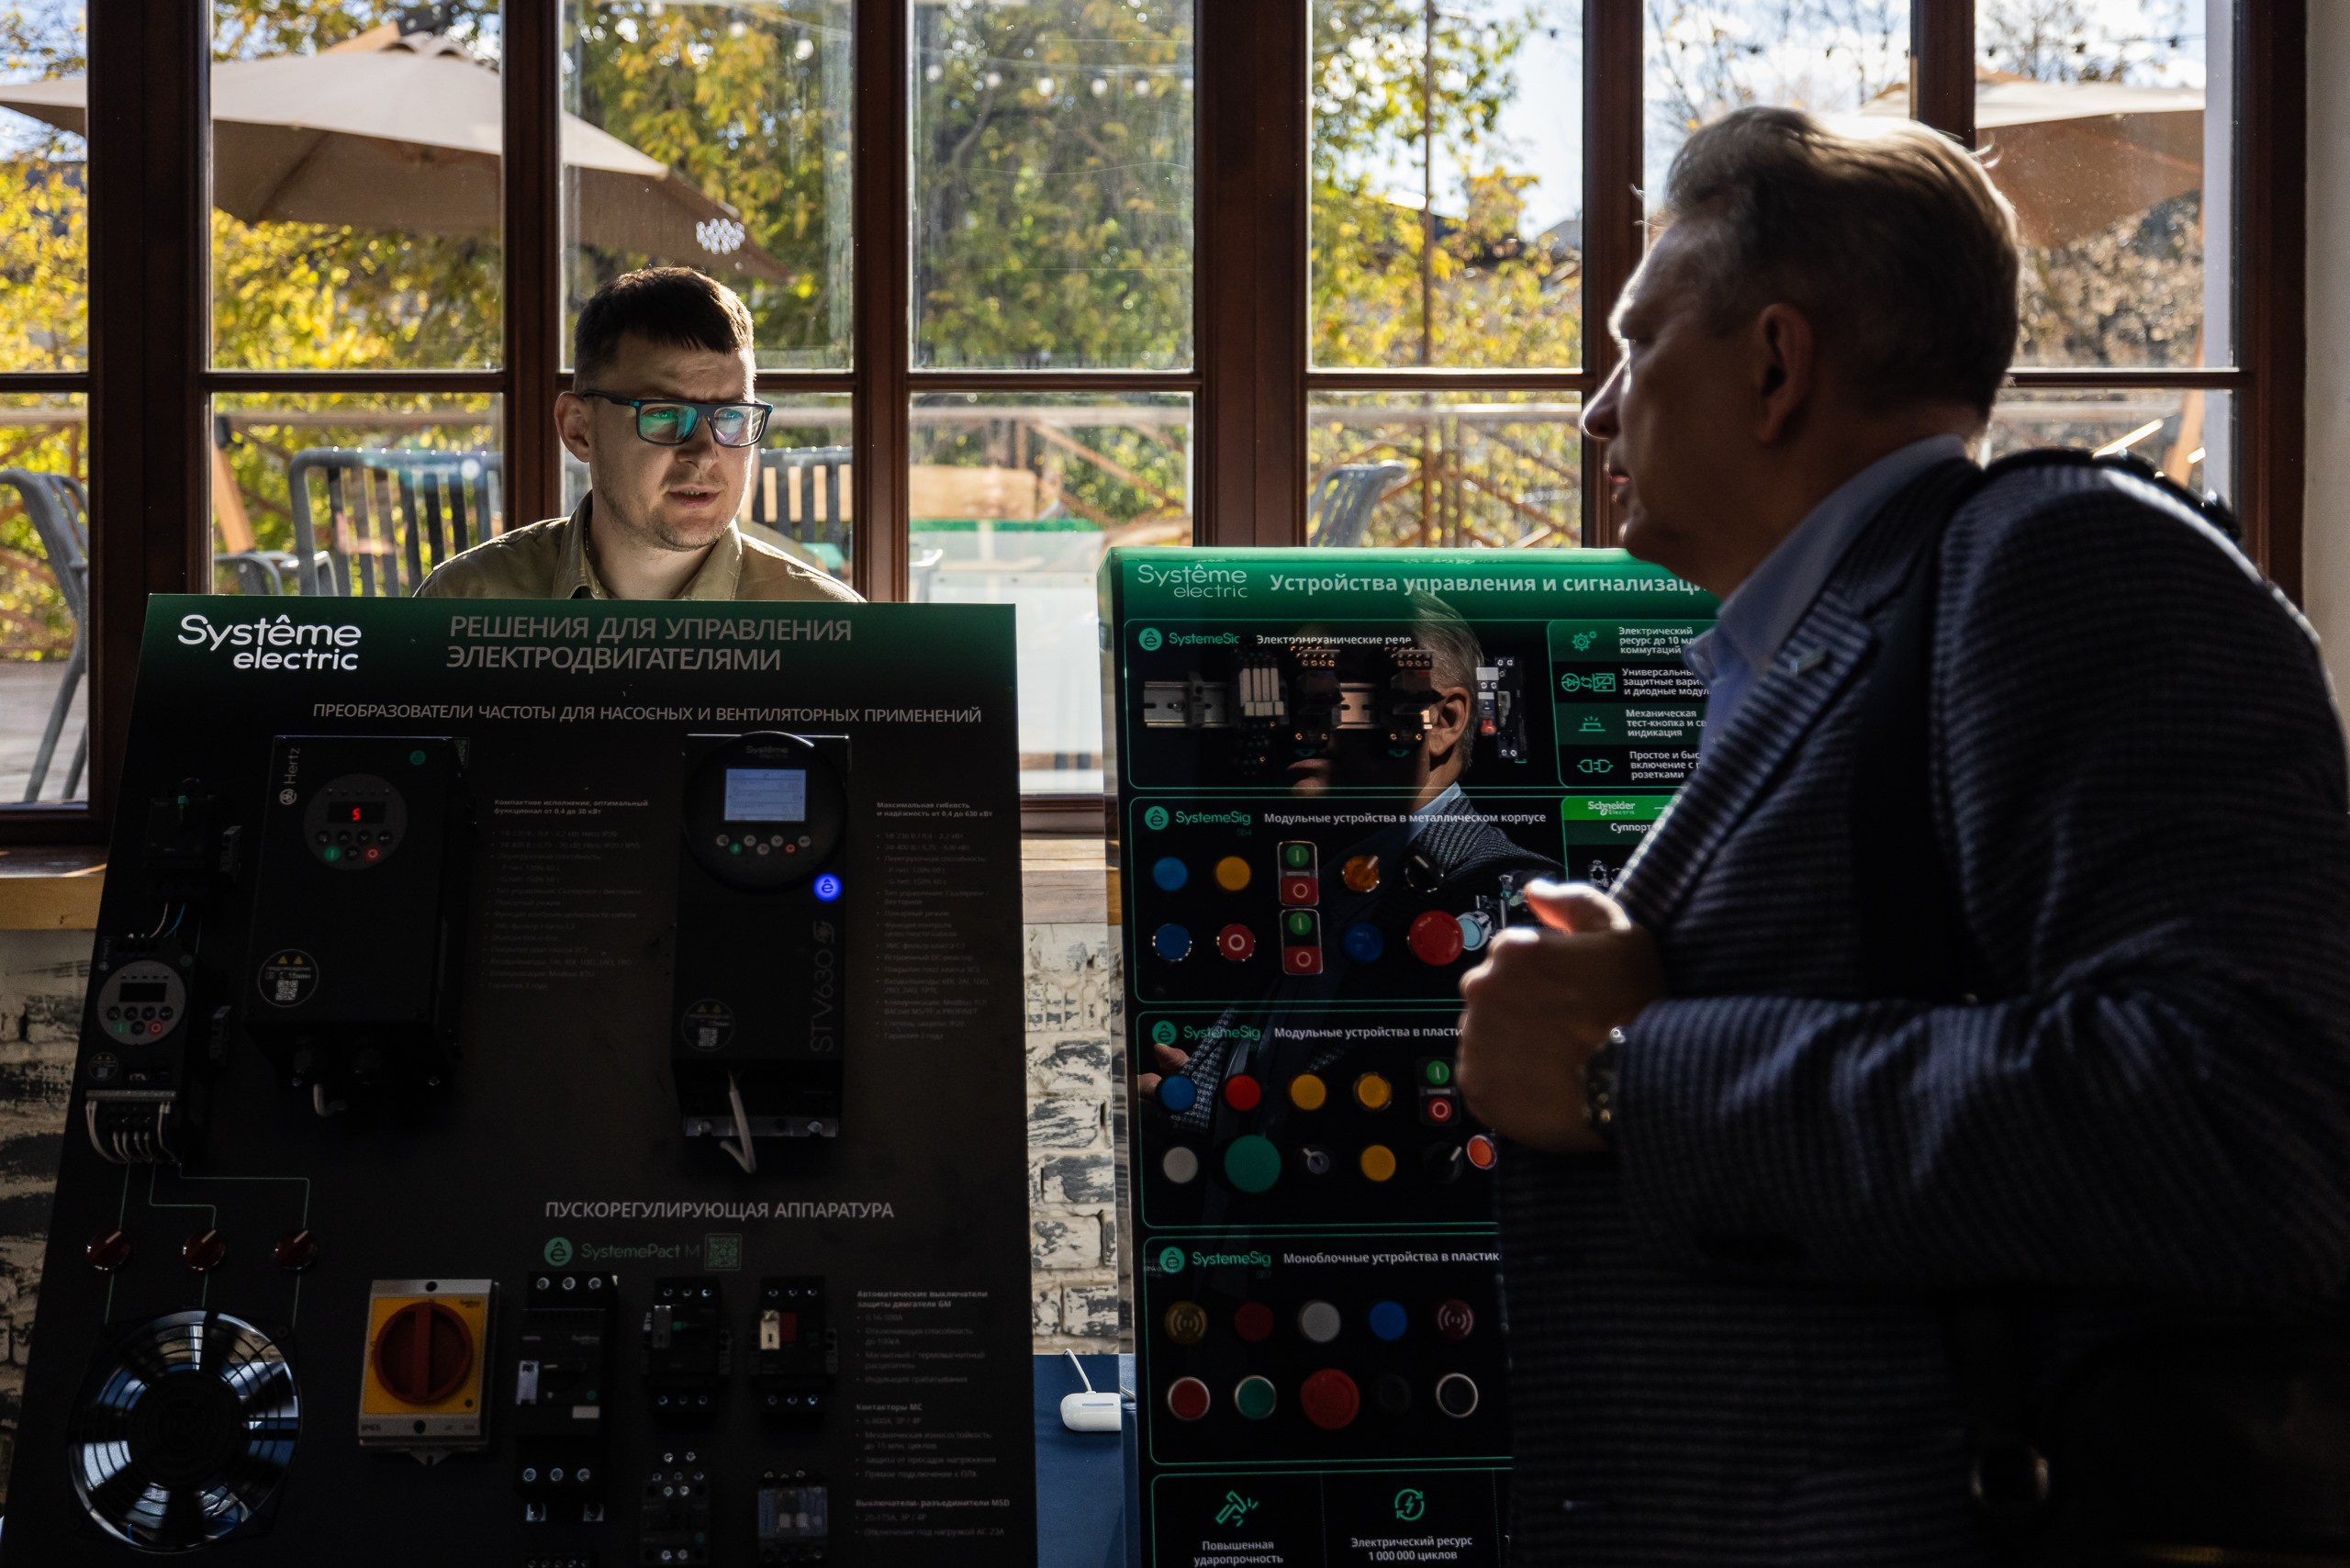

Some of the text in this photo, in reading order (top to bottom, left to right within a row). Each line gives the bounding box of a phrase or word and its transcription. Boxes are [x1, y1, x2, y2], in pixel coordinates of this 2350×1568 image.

[1138, 564, 1247, 587] Systême
[1174, 583, 1248, 598] electric
[1270, 575, 1398, 595] Устройства
[1404, 577, 1537, 596] управления
[1543, 578, 1557, 591] и
[177, 614, 362, 649] Systême
[450, 616, 852, 644] РЕШЕНИЯ ДЛЯ УПРАВЛЕНИЯ
[1619, 627, 1693, 636] Электрический
[1257, 635, 1382, 644] Электромеханические
[1620, 637, 1652, 646] ресурс
[1621, 646, 1681, 655] коммутаций
[233, 648, 358, 670] electric
[446, 645, 780, 674] ЭЛЕКТРОДВИГАТЕЛЯМИ
[313, 703, 982, 723] ПРЕОБРАЗОВАТЕЛИ ЧАСТОТЫ ДЛЯ НАСОСНЫХ И ВЕНТИЛЯТОРНЫХ ПРИМЕНЕНИЙ
[1628, 729, 1682, 737] индикация
[1629, 752, 1669, 760] Простое
[1681, 751, 1699, 759] быс
[284, 747, 301, 784] Hertz
[1632, 771, 1684, 780] розетками
[1588, 801, 1636, 810] Schneider
[1176, 811, 1251, 825] SystemeSig
[1264, 813, 1331, 826] Модульные
[1334, 813, 1397, 825] устройства
[1409, 814, 1498, 823] металлическом
[1501, 814, 1547, 825] корпусе
[1611, 823, 1651, 834] Суппорт
[811, 949, 834, 1053] STV630
[1184, 1025, 1260, 1040] SystemeSig
[1275, 1026, 1463, 1040] Модульные устройства в пласти
[545, 1202, 894, 1221] ПУСКОРЕГУЛИРУЮЩАЯ АППАРАТУРА
[581, 1243, 680, 1260] SystemePact
[686, 1245, 699, 1258] M
[1283, 1252, 1369, 1264] Моноблочные
[1372, 1251, 1438, 1265] устройства
[1452, 1252, 1500, 1261] пластик
[1192, 1251, 1271, 1267] SystemeSig
[856, 1404, 907, 1412] Контакторы
[1203, 1540, 1273, 1551] Повышенная
[1351, 1536, 1472, 1549] Электрический ресурс
[1193, 1553, 1283, 1568] ударопрочность
[1376, 1551, 1394, 1562] 000
[1396, 1551, 1416, 1562] 000
[1417, 1550, 1457, 1562] циклов
